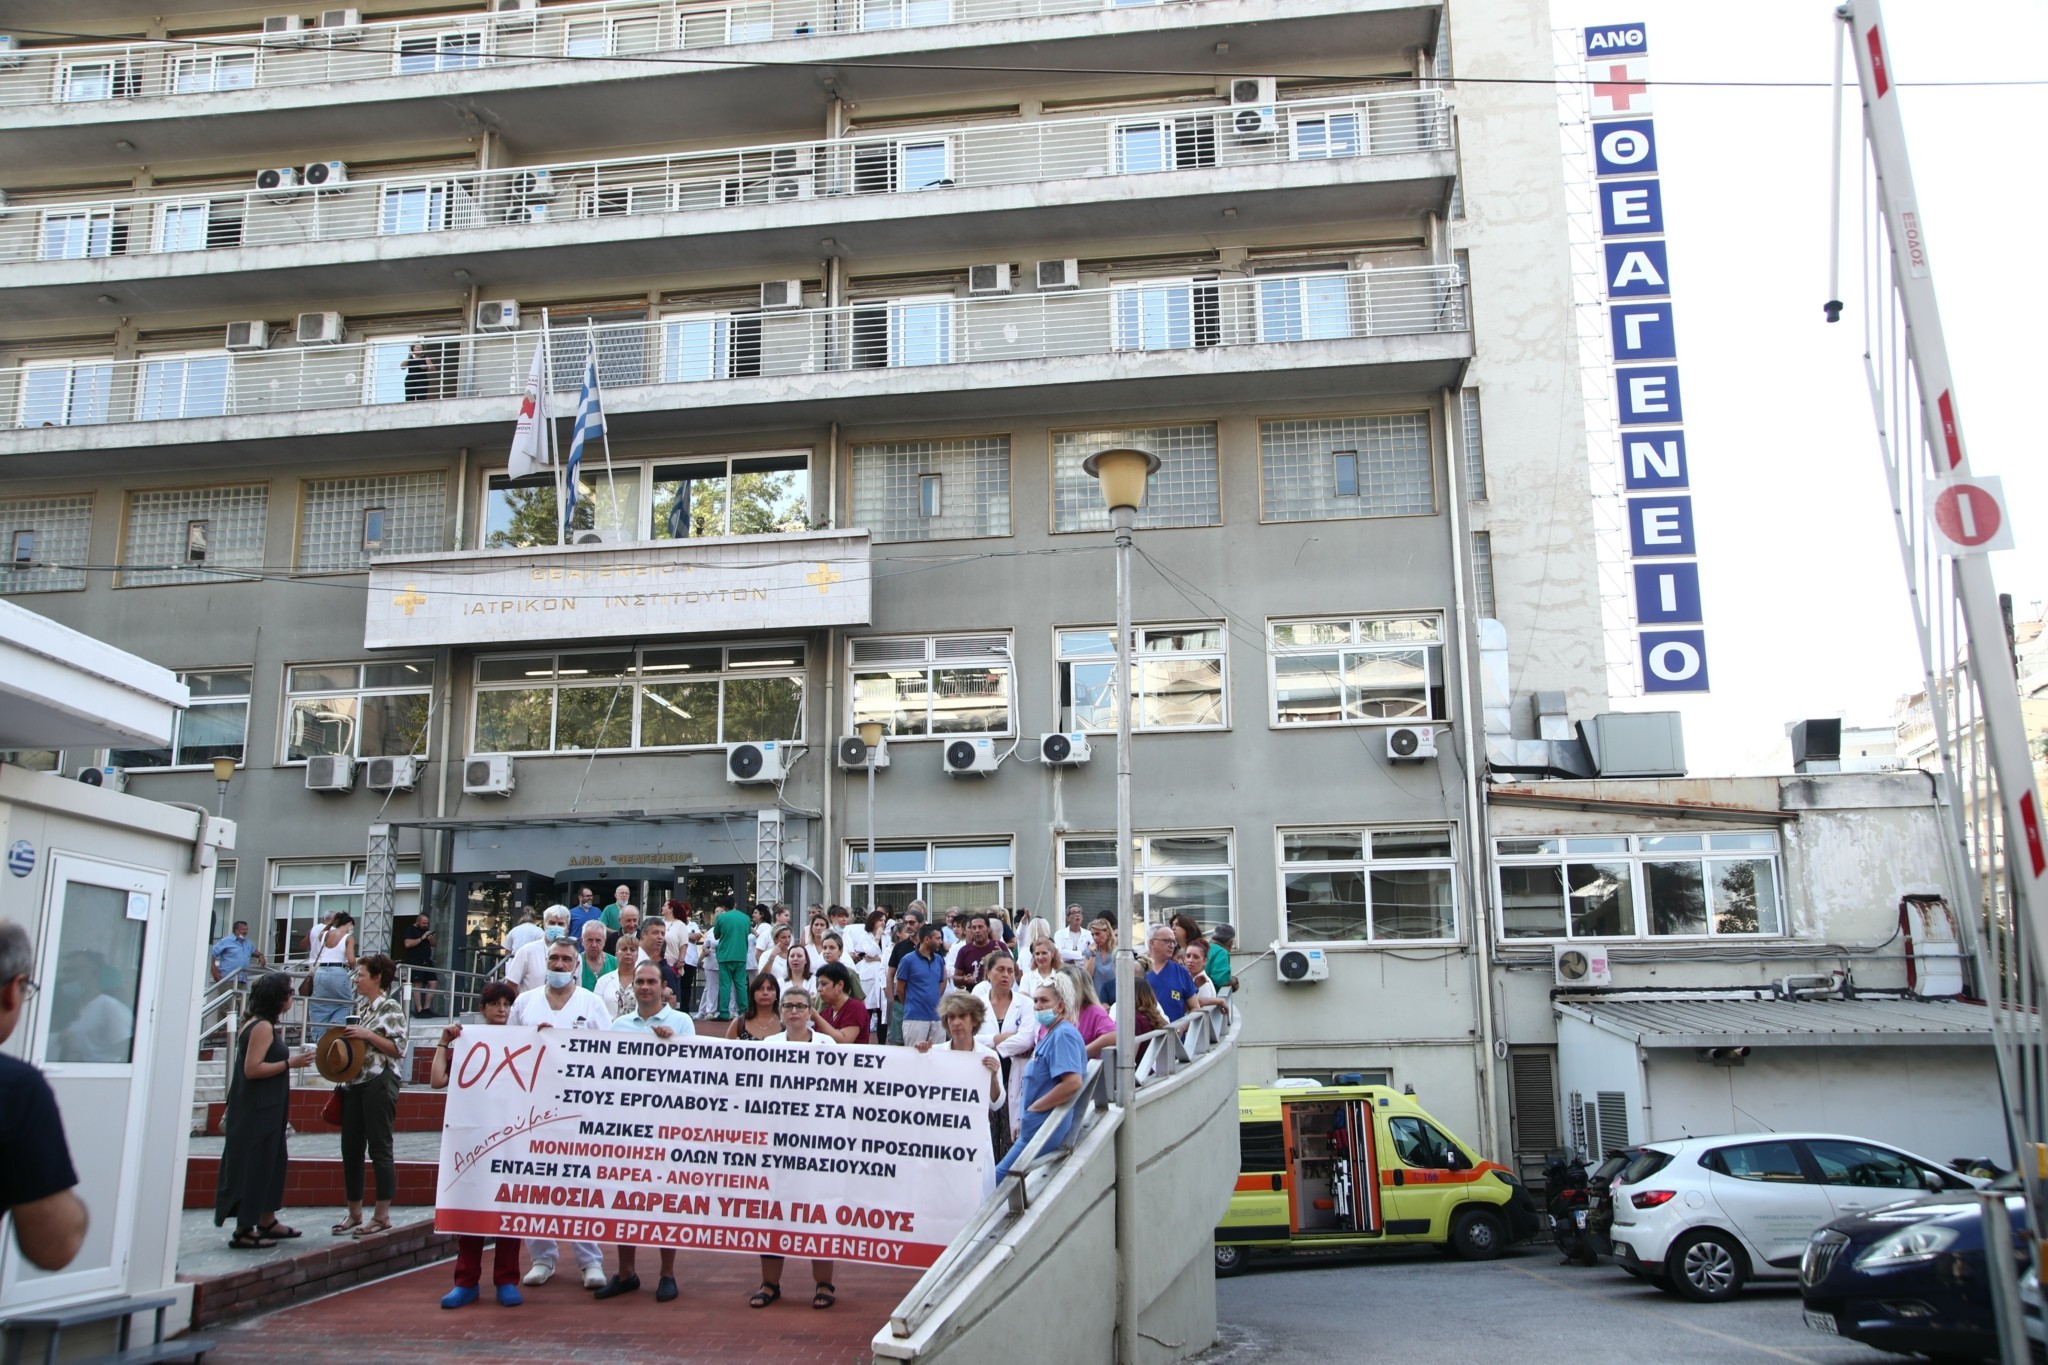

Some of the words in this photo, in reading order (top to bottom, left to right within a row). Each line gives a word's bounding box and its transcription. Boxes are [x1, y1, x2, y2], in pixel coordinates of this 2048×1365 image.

[1589, 29, 1643, 49] ΑΝΘ
[1902, 212, 1925, 267] ΕΞΟΔΟΣ
[1600, 128, 1702, 681] ΘΕΑΓΕΝΕΙΟ
[463, 598, 576, 616] ΙΑΤΡΙΚΟΝ
[604, 587, 767, 609] ΙΝΣΤΙΤΟΥΤΟΝ
[457, 1041, 547, 1093] ΟΧΙ
[617, 1041, 810, 1064] ΕΜΠΟΡΕΥΜΑΤΟΠΟΙΗΣΗ
[816, 1051, 848, 1067] ΤΟΥ
[853, 1053, 886, 1069] ΕΣΥ
[601, 1066, 729, 1086] ΑΠΟΓΕΥΜΑΤΙΝΑ
[735, 1072, 764, 1088] ΕΠΙ
[769, 1074, 858, 1093] ΠΛΗΡΩΜΗ
[863, 1080, 980, 1103] ΧΕΙΡΟΥΡΓΕΙΑ
[620, 1092, 729, 1112] ΕΡΓΟΛΑΒΟΥΣ
[744, 1099, 810, 1117] ΙΔΙΩΤΕΣ
[814, 1103, 846, 1119] ΣΤΑ
[852, 1106, 972, 1130] ΝΟΣΟΚΟΜΕΙΑ
[528, 1139, 666, 1162] ΜΟΝΙΜΟΠΟΙΗΣΗ
[670, 1148, 718, 1165] ΟΛΩΝ
[723, 1151, 757, 1167] ΤΩΝ
[761, 1154, 897, 1178] ΣΥΜΒΑΣΙΟΥΧΩΝ
[578, 1121, 654, 1139] ΜΑΖΙΚΕΣ
[657, 1125, 769, 1146] ΠΡΟΣΛΗΨΕΙΣ
[773, 1132, 857, 1151] ΜΟΝΙΜΟΥ
[861, 1138, 978, 1162] ΠΡΟΣΩΠΙΚΟΥ
[490, 1159, 558, 1177] ΕΝΤΑΞΗ
[561, 1163, 592, 1179] ΣΤΑ
[596, 1166, 653, 1183] ΒΑΡΕΑ
[666, 1170, 770, 1191] ΑΝΘΥΓΙΕΙΝΑ
[1424, 1173, 1439, 1182] 166
[494, 1182, 605, 1209] ΔΗΜΟΣΙΑ
[611, 1190, 710, 1216] ΔΩΡΕΑΝ
[717, 1197, 784, 1221] ΥΓΕΙΑ
[790, 1202, 828, 1225] ΓΙΑ
[835, 1205, 915, 1232] ΟΛΟΥΣ
[499, 1214, 606, 1238] ΣΩΜΑΤΕΙΟ
[615, 1222, 771, 1249] ΕΡΓΑΖΟΜΕΝΩΝ
[779, 1233, 904, 1261] ΘΕΑΓΕΝΕΙΟΥ
